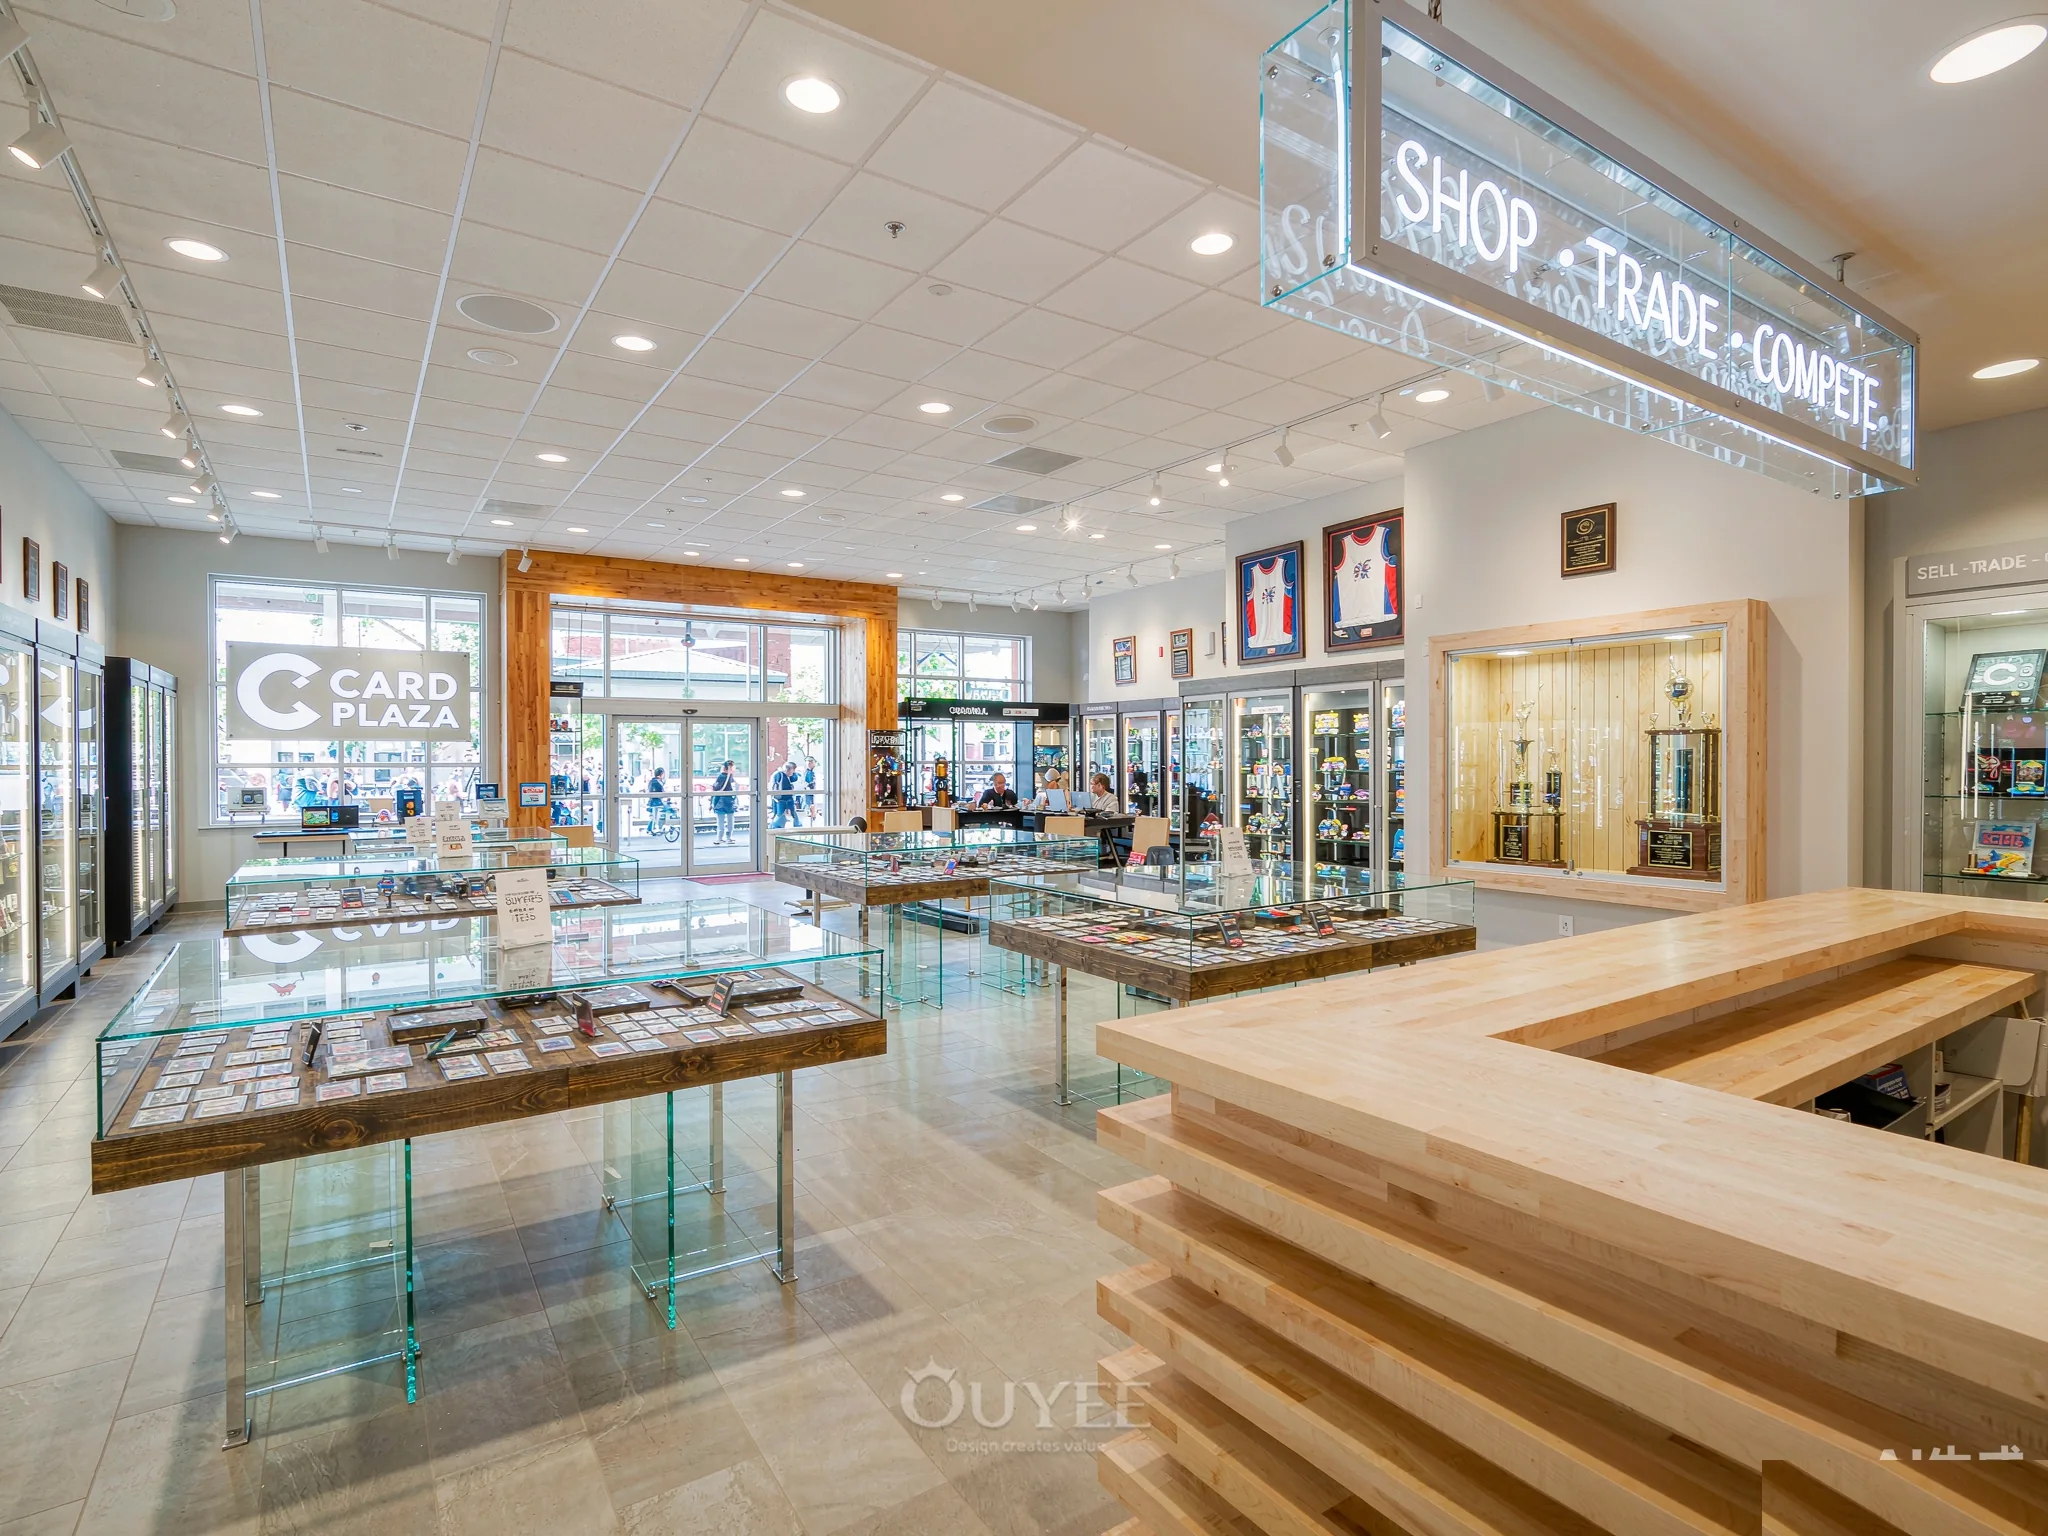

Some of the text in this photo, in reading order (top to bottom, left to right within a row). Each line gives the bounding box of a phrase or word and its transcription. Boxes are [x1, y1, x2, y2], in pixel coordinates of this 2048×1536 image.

[1395, 139, 1880, 432] SHOP TRADE COMPETE
[1917, 563, 1959, 580] SELL
[329, 668, 459, 701] CARD
[331, 701, 461, 729] PLAZA
